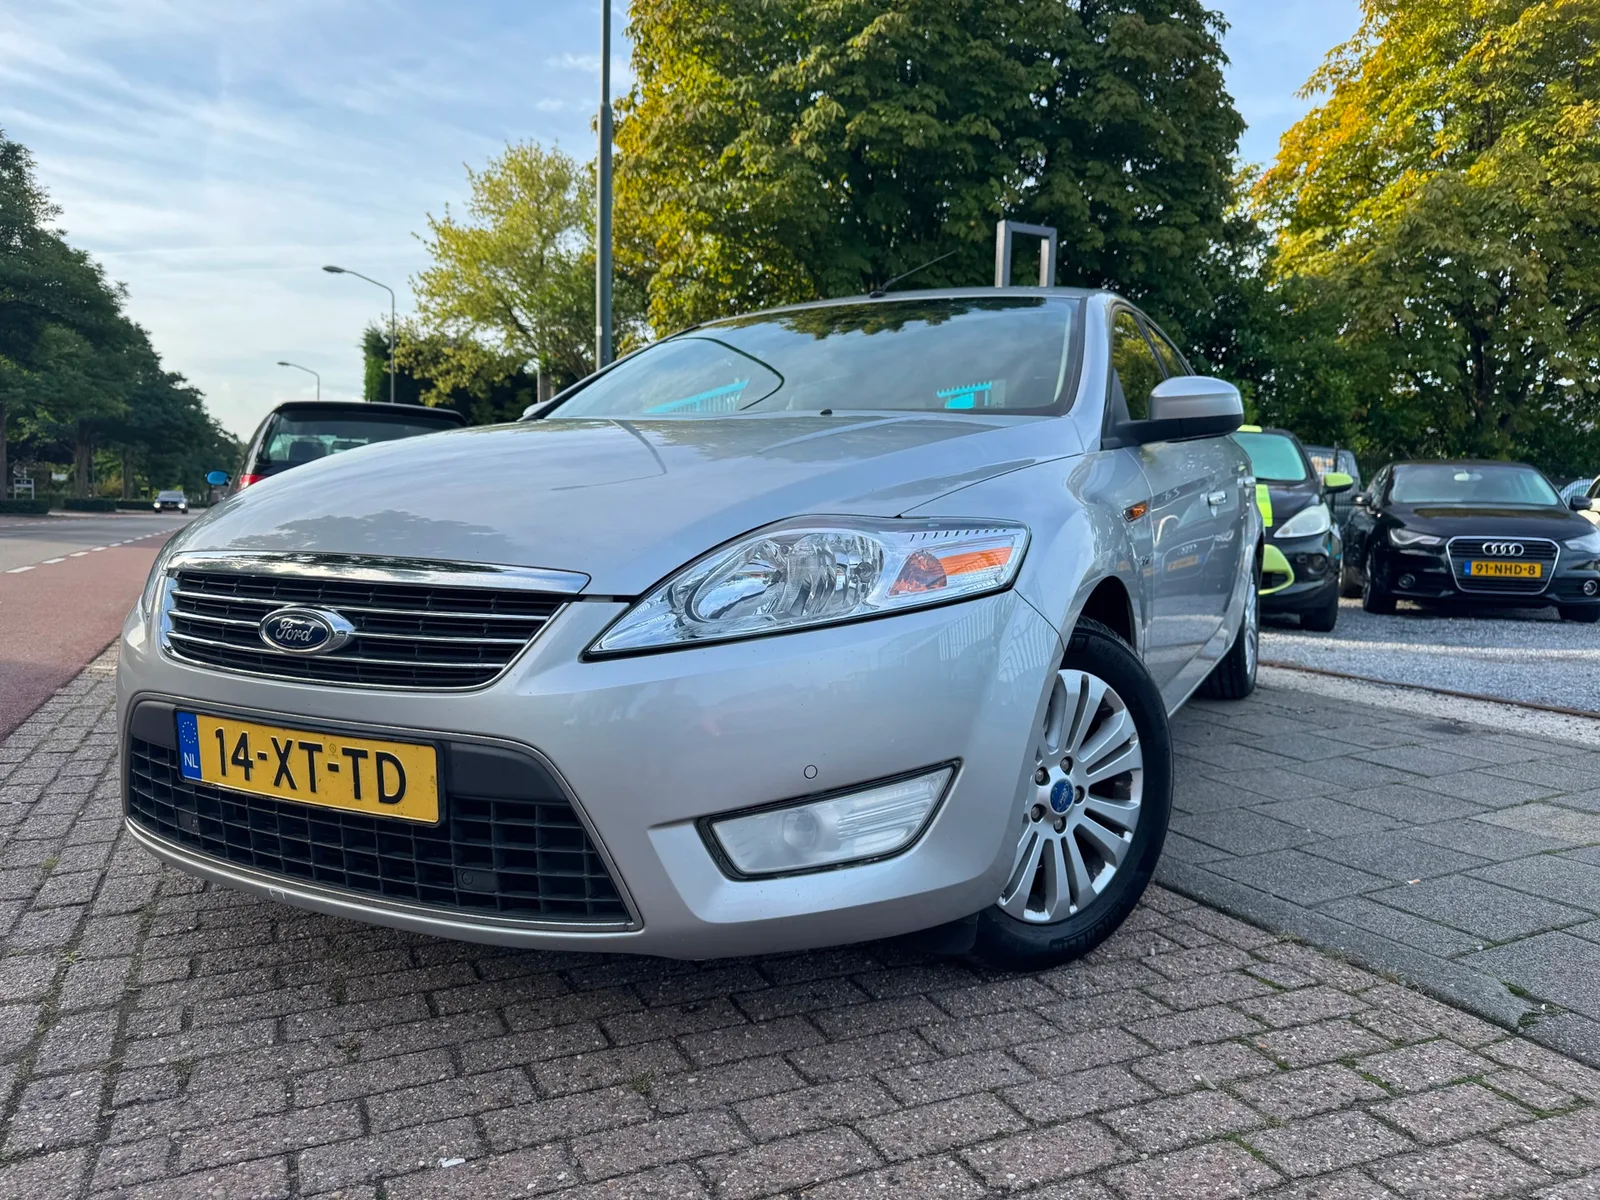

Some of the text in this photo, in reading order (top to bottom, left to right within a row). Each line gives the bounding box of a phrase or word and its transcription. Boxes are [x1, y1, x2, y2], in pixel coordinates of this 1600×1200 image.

[1475, 563, 1536, 576] 91-NHD-8
[275, 617, 315, 642] Ford
[184, 753, 199, 769] NL
[215, 727, 407, 805] 14-XT-TD
